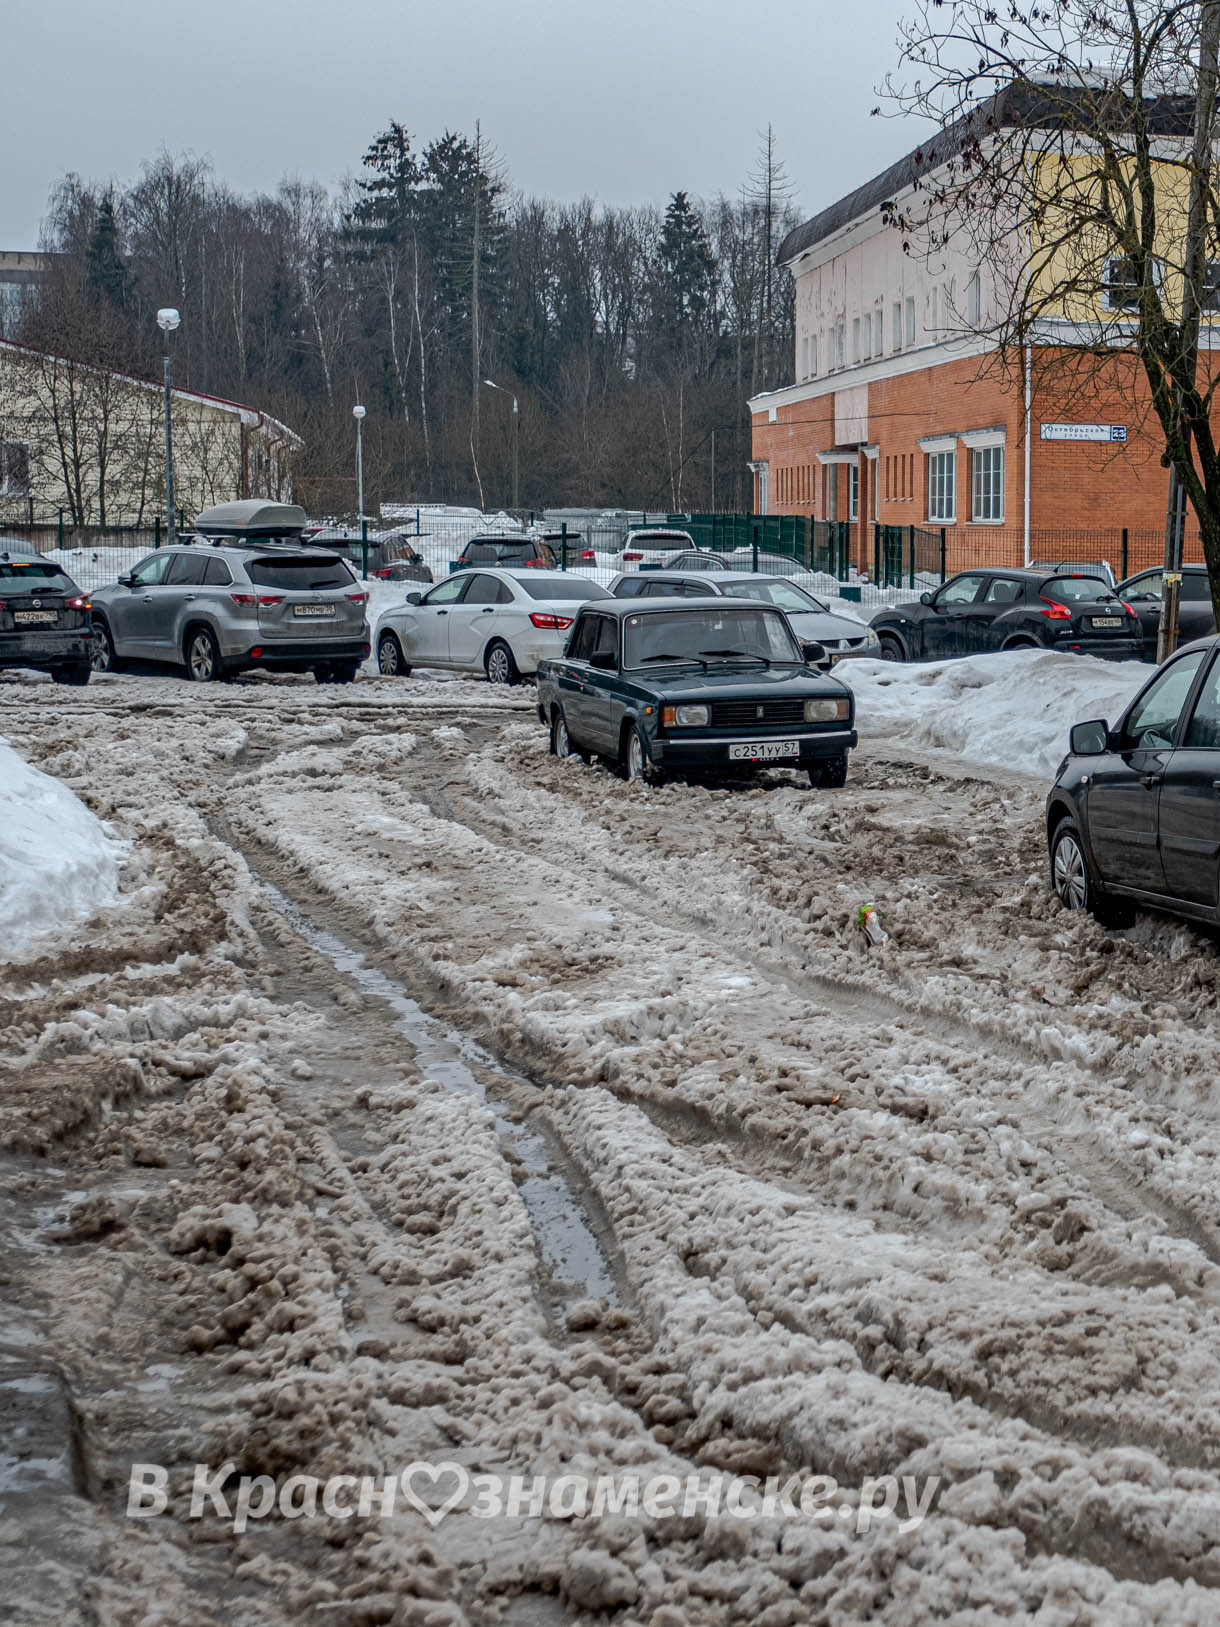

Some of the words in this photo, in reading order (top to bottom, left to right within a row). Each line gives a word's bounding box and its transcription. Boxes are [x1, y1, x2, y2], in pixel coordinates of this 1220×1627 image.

[1112, 428, 1125, 437] 23
[734, 745, 781, 757] С251УУ
[784, 743, 796, 752] 57
